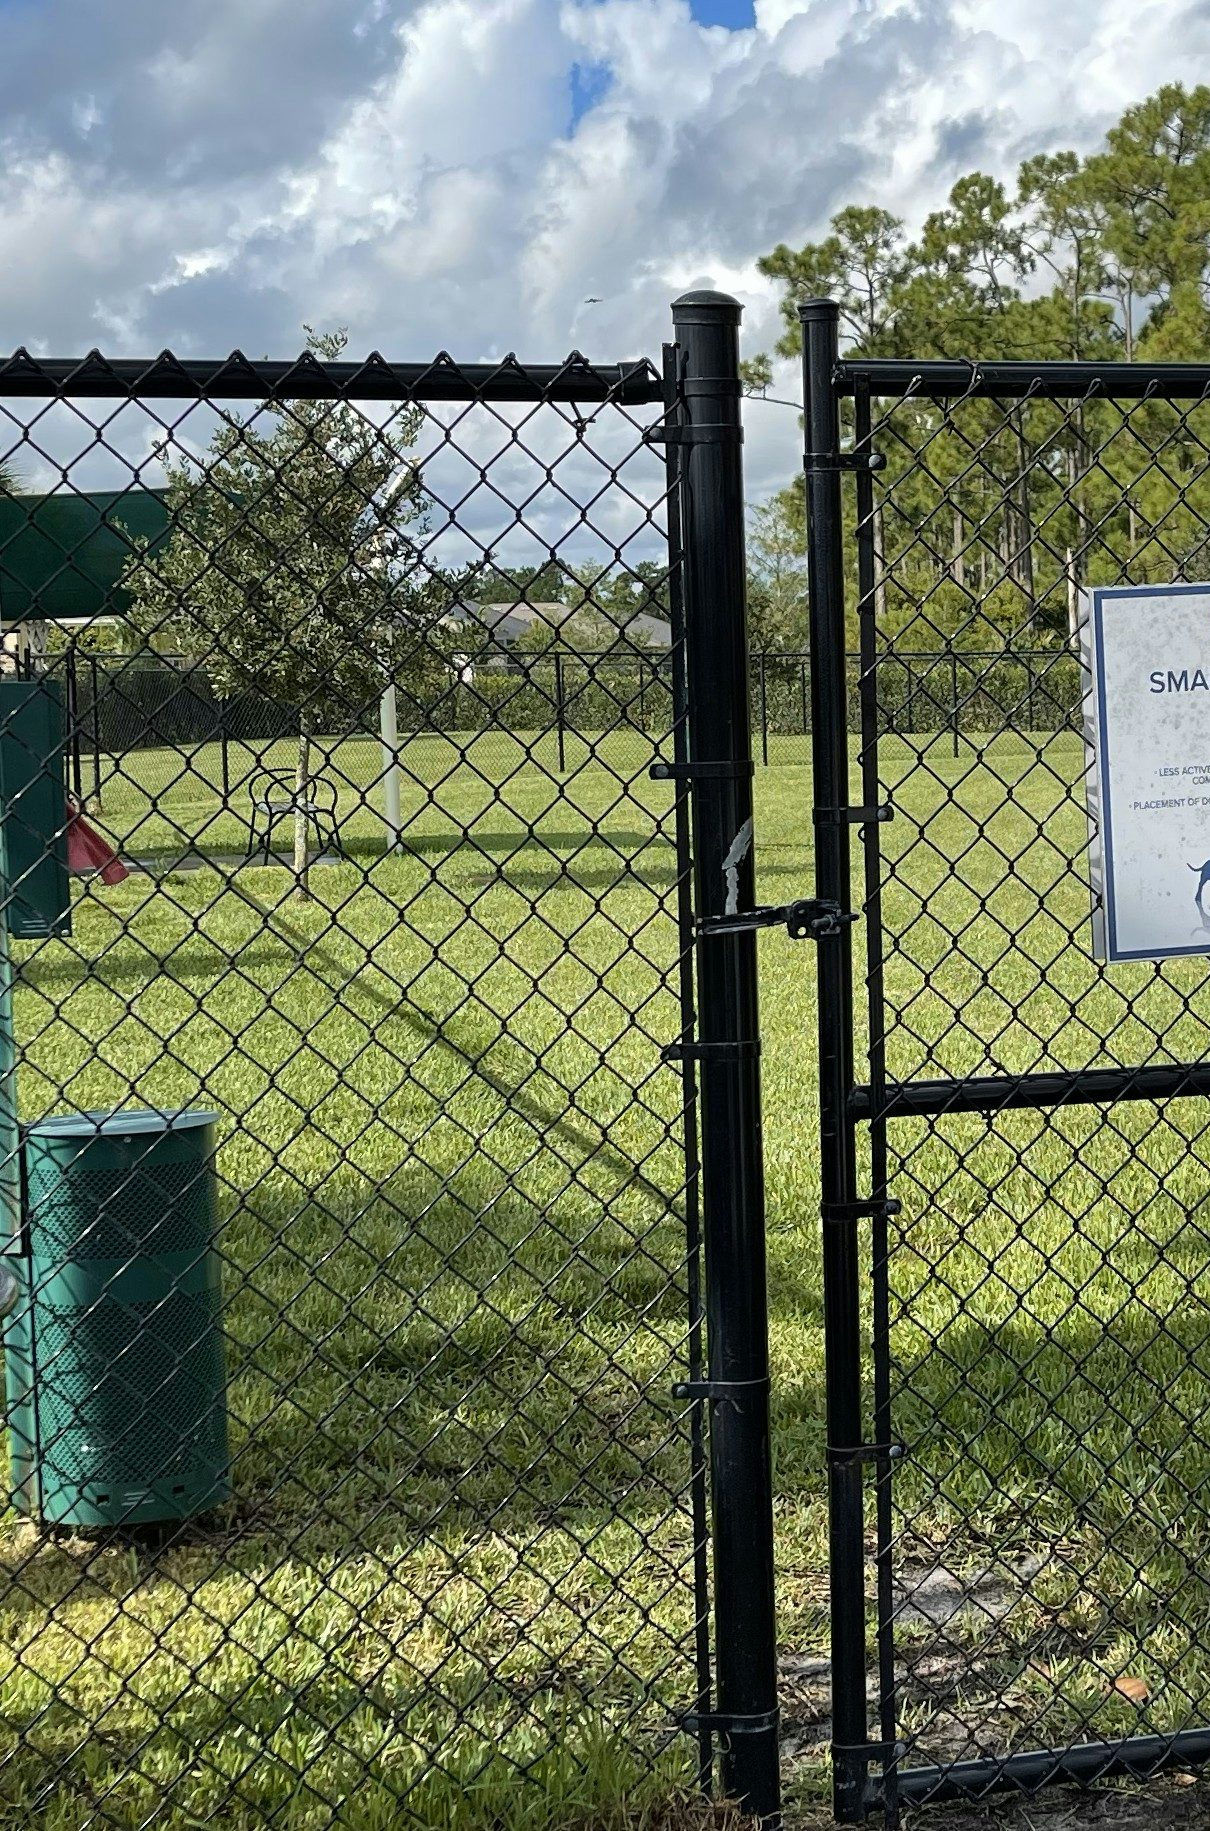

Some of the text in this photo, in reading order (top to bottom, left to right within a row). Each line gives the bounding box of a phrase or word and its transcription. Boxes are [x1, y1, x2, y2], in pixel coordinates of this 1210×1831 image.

[1159, 767, 1180, 777] LESS
[1133, 799, 1187, 810] PLACEMENT
[1187, 798, 1199, 806] OF
